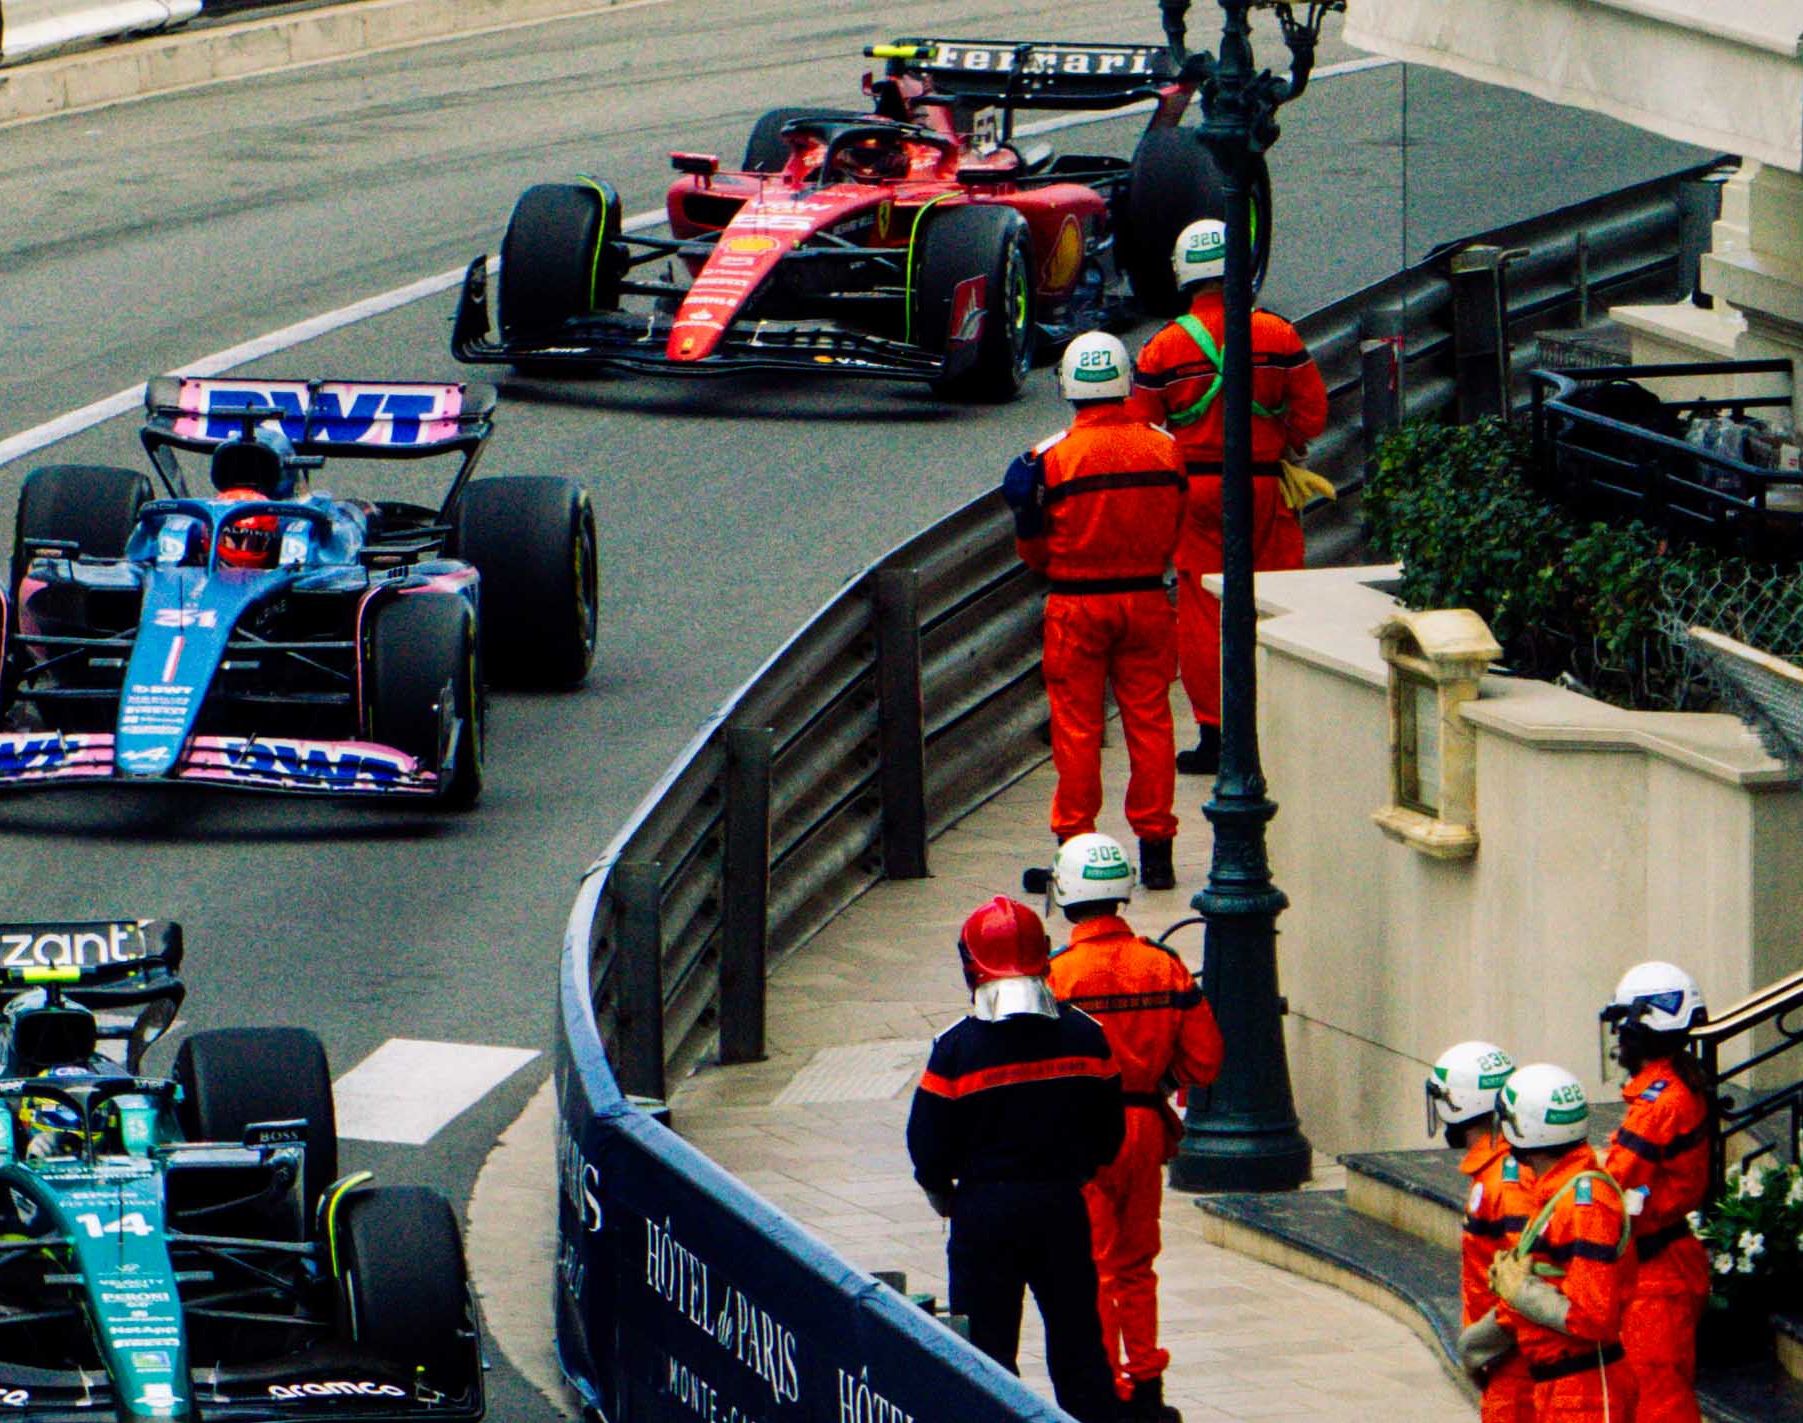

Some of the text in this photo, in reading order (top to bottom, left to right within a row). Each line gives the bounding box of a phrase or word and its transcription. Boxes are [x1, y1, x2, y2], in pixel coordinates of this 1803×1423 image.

[935, 46, 1152, 75] Ferrari
[1188, 231, 1221, 249] 320
[1079, 350, 1111, 367] 227
[205, 390, 435, 444] BWT
[1086, 844, 1122, 863] 302
[1550, 1083, 1585, 1105] 422
[259, 1131, 299, 1143] BOSS
[75, 1211, 155, 1238] 14
[644, 1217, 715, 1336] HÔTEL
[716, 1284, 734, 1351] de
[736, 1291, 800, 1403] PARIS
[268, 1380, 407, 1399] aramco
